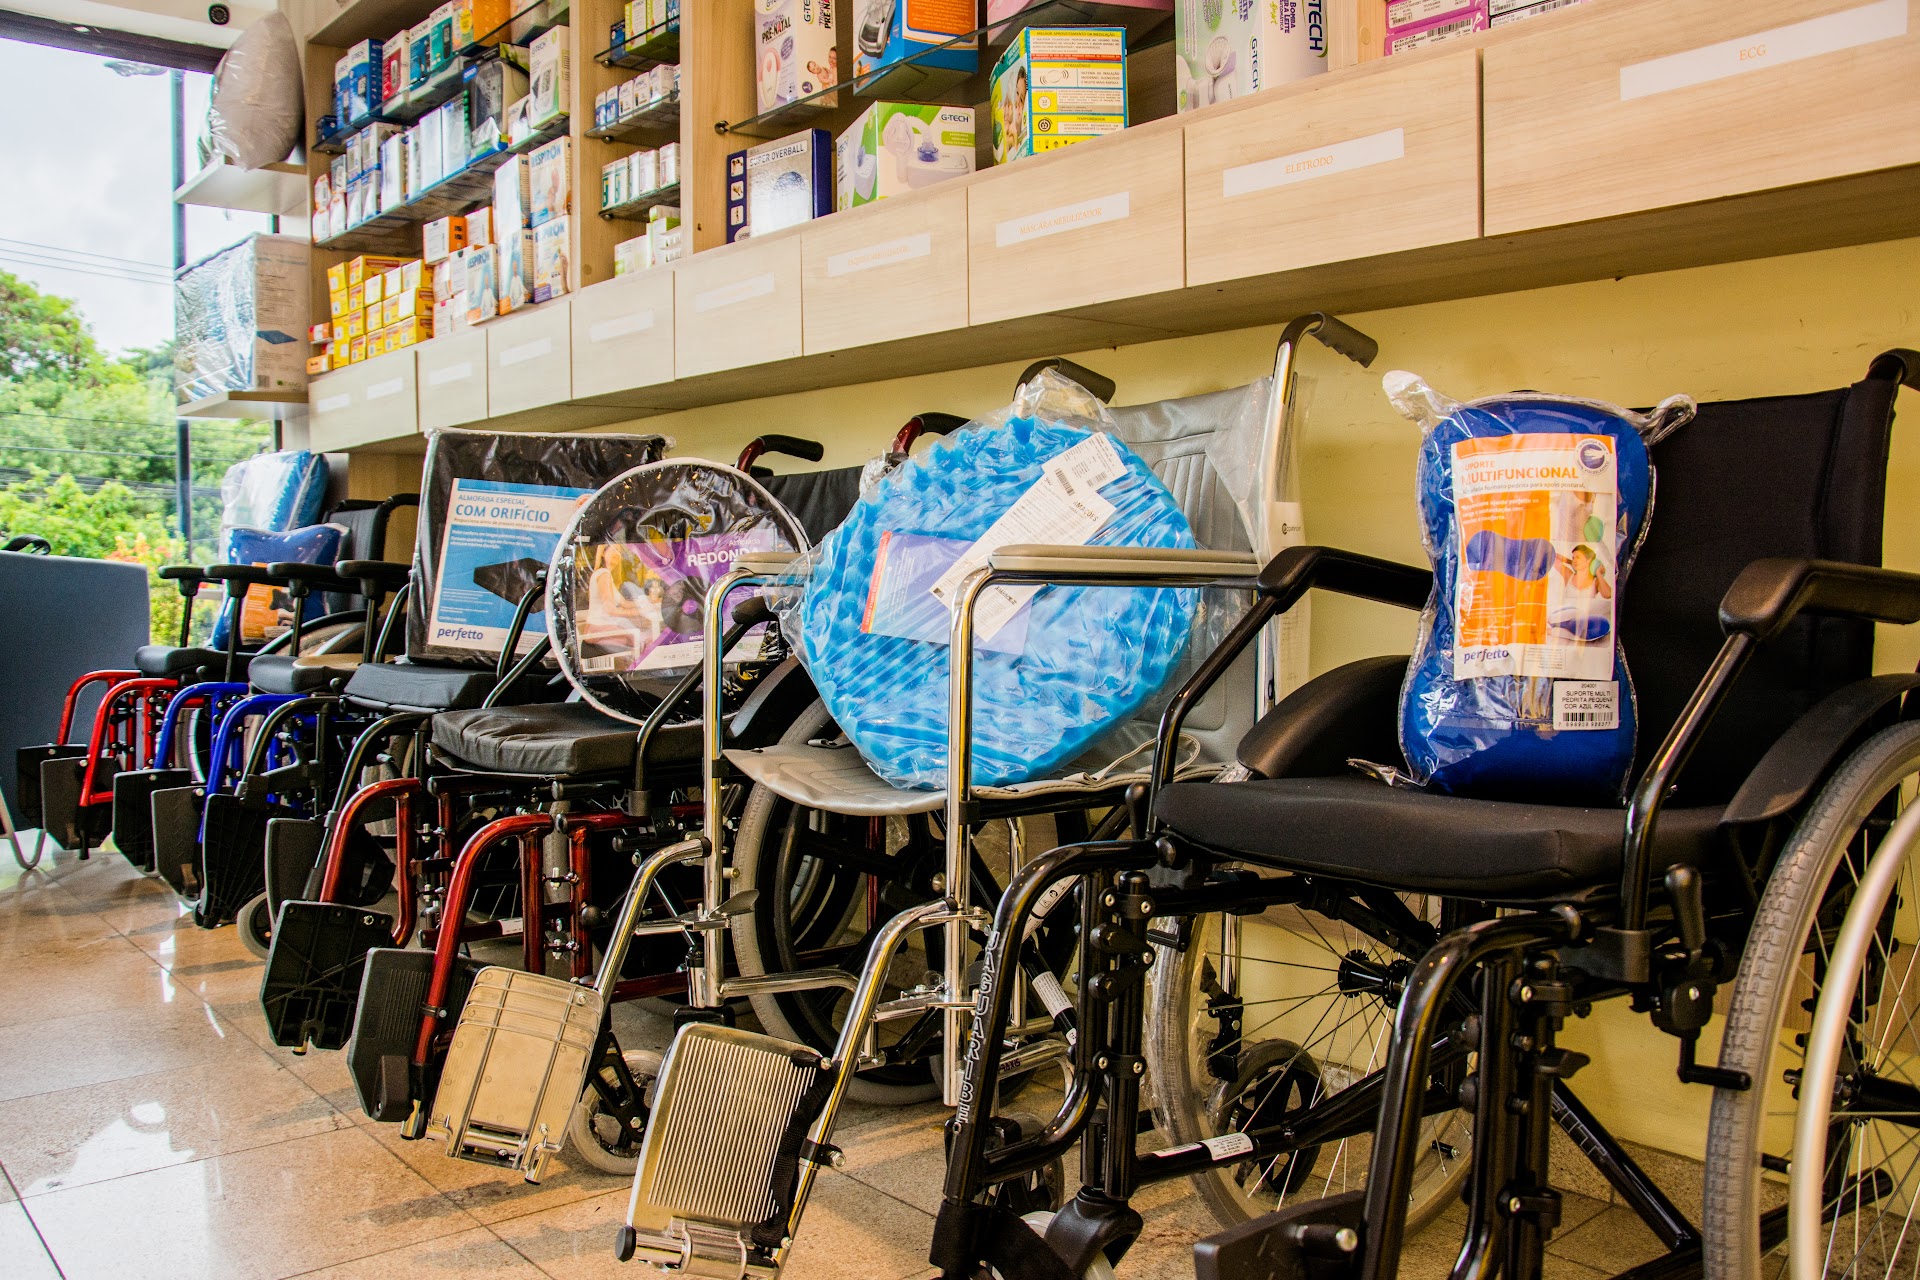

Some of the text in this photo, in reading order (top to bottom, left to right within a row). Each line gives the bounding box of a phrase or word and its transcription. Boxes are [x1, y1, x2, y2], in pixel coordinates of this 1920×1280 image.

[1308, 0, 1323, 51] TECH
[1739, 44, 1766, 61] ECG
[749, 143, 805, 167] SUPER OVERBALL
[1285, 155, 1334, 174] ELETRODO
[1461, 466, 1579, 487] MULTIFUNCIONAL
[458, 494, 526, 505] ALMOFADA ESPECIAL
[455, 504, 550, 523] COM ORIFÍCIO
[437, 627, 484, 641] perfetto
[1463, 648, 1510, 664] perfetto
[959, 930, 1001, 1124] JAGUARIBE
